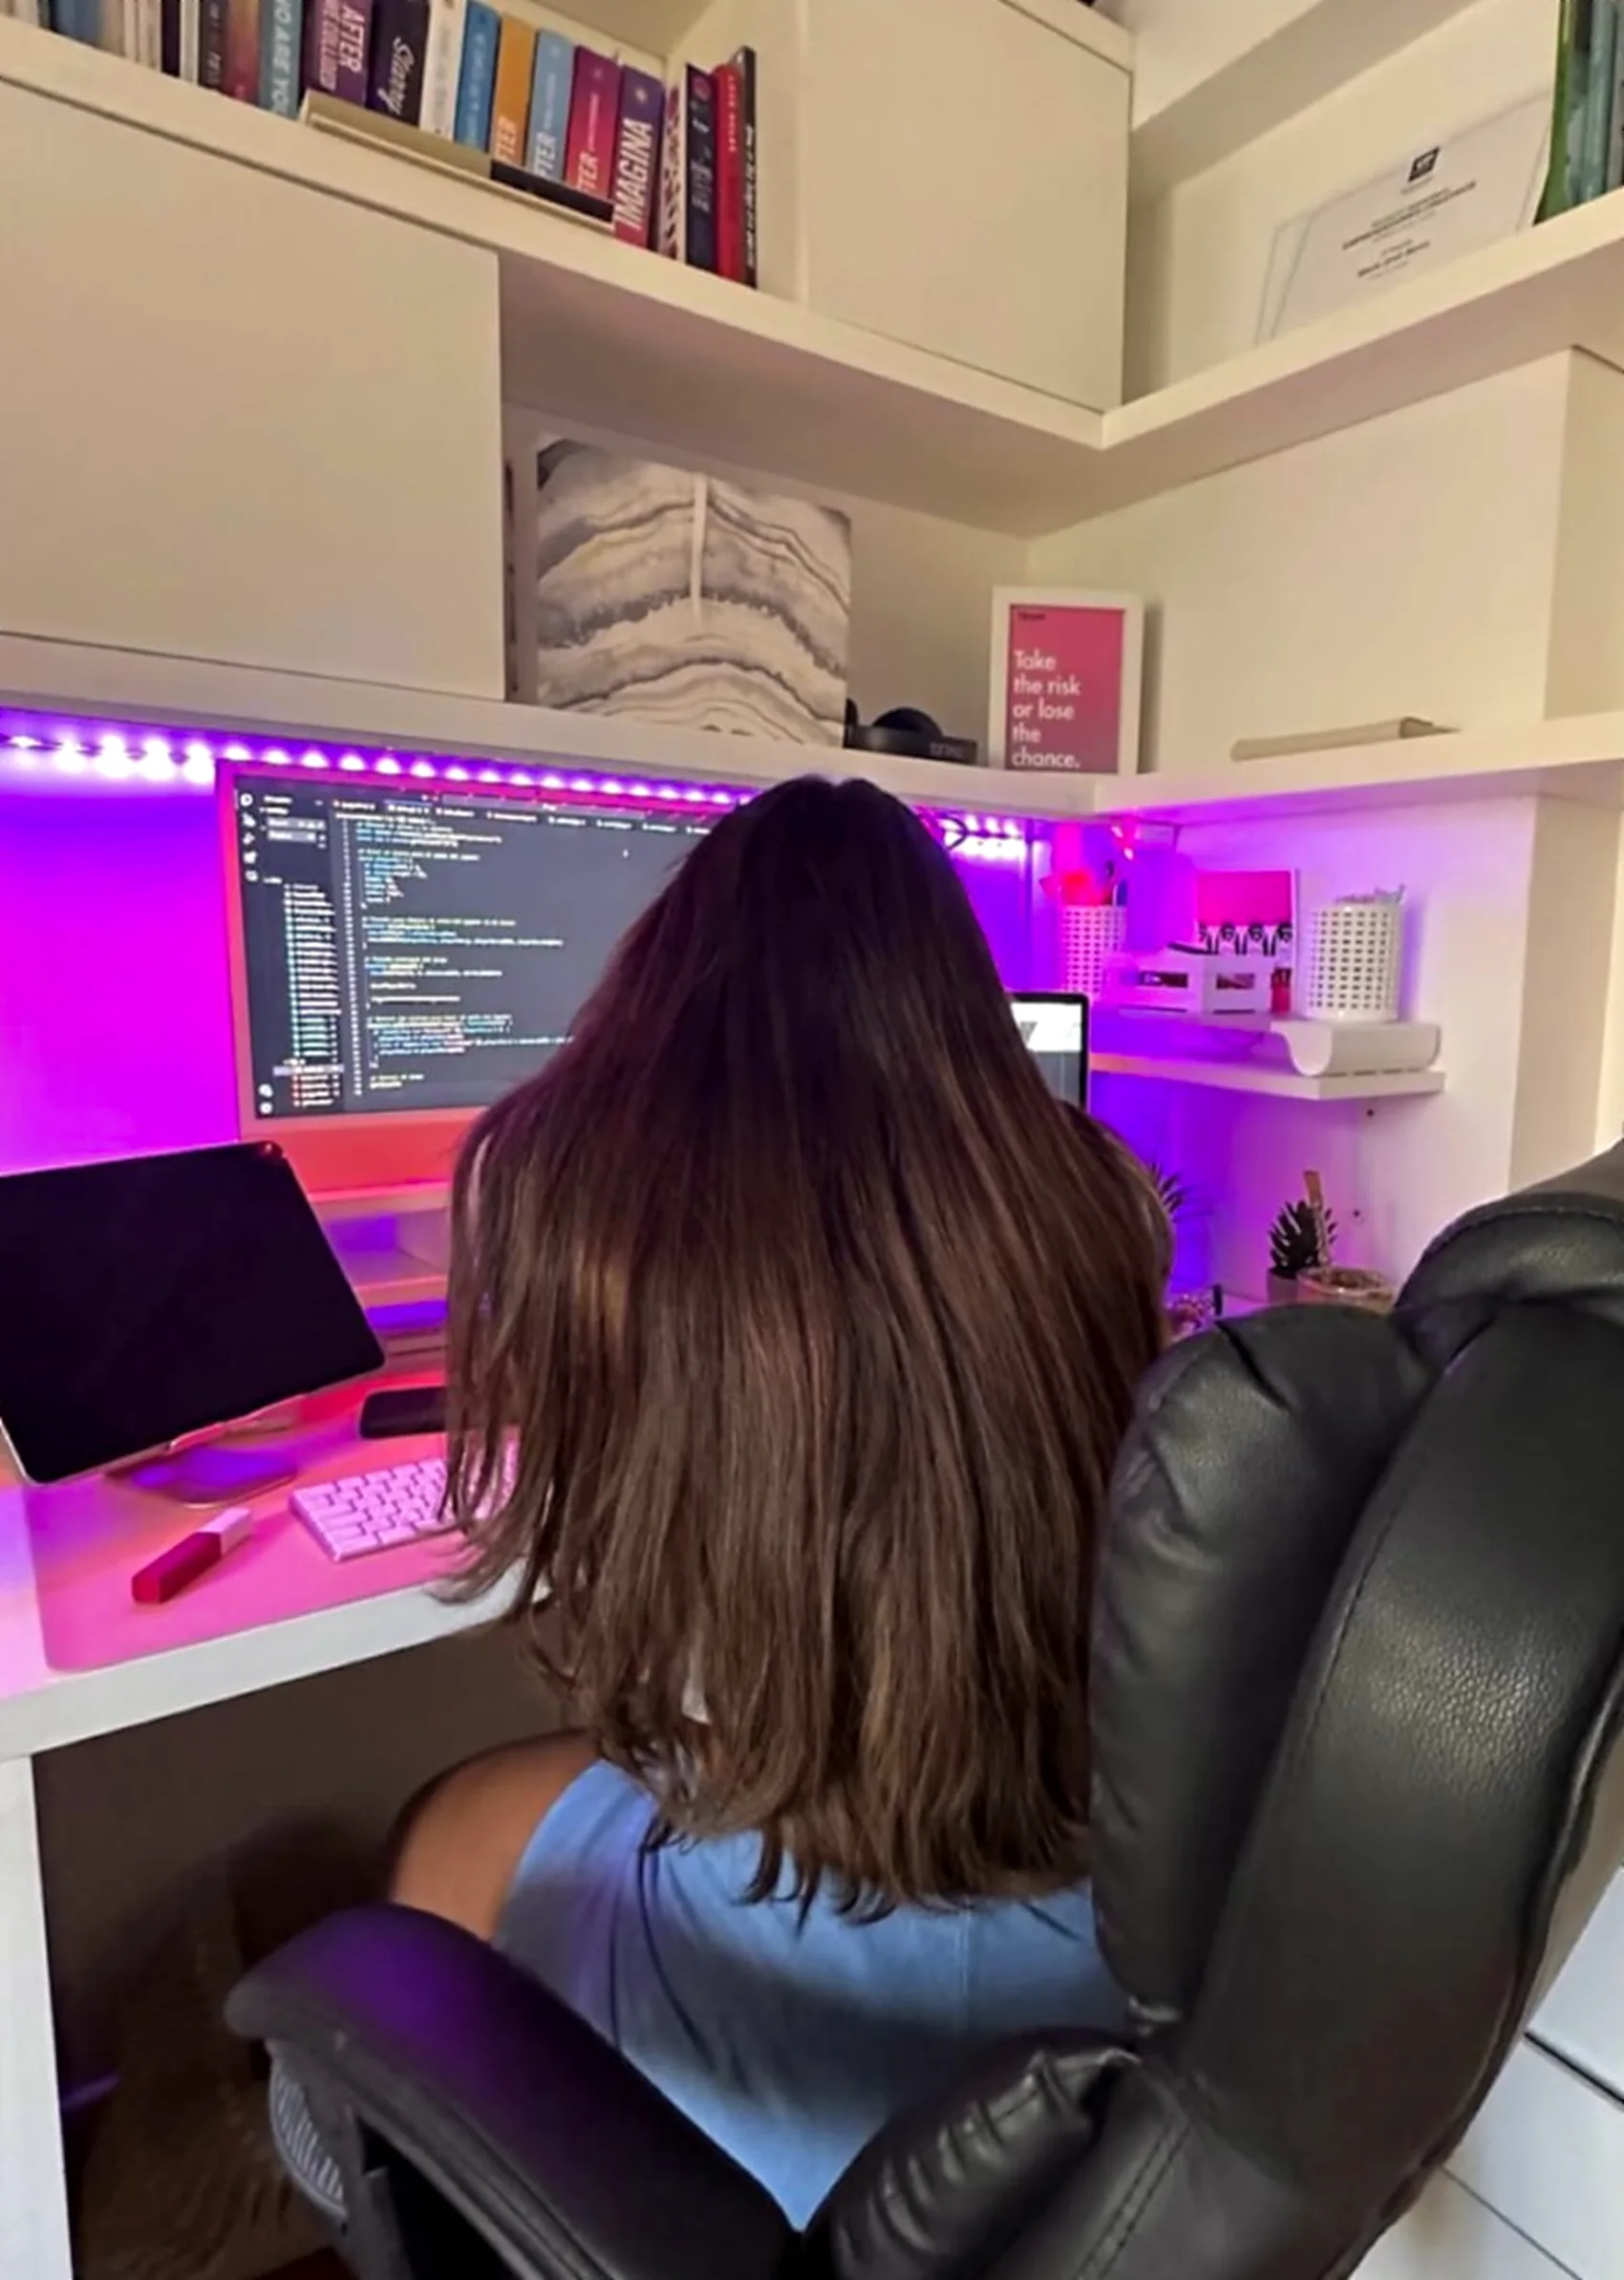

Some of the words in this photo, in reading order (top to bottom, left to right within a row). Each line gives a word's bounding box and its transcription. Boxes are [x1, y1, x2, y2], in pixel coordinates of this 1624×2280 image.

[338, 5, 365, 73] AFTER
[614, 117, 652, 230] IMAGINA
[1013, 647, 1057, 670] Take
[1013, 673, 1043, 695] the
[1047, 673, 1081, 696] risk
[1013, 702, 1035, 719] or
[1038, 698, 1076, 721] lose
[1012, 721, 1042, 743] the
[1011, 745, 1081, 769] chance.
